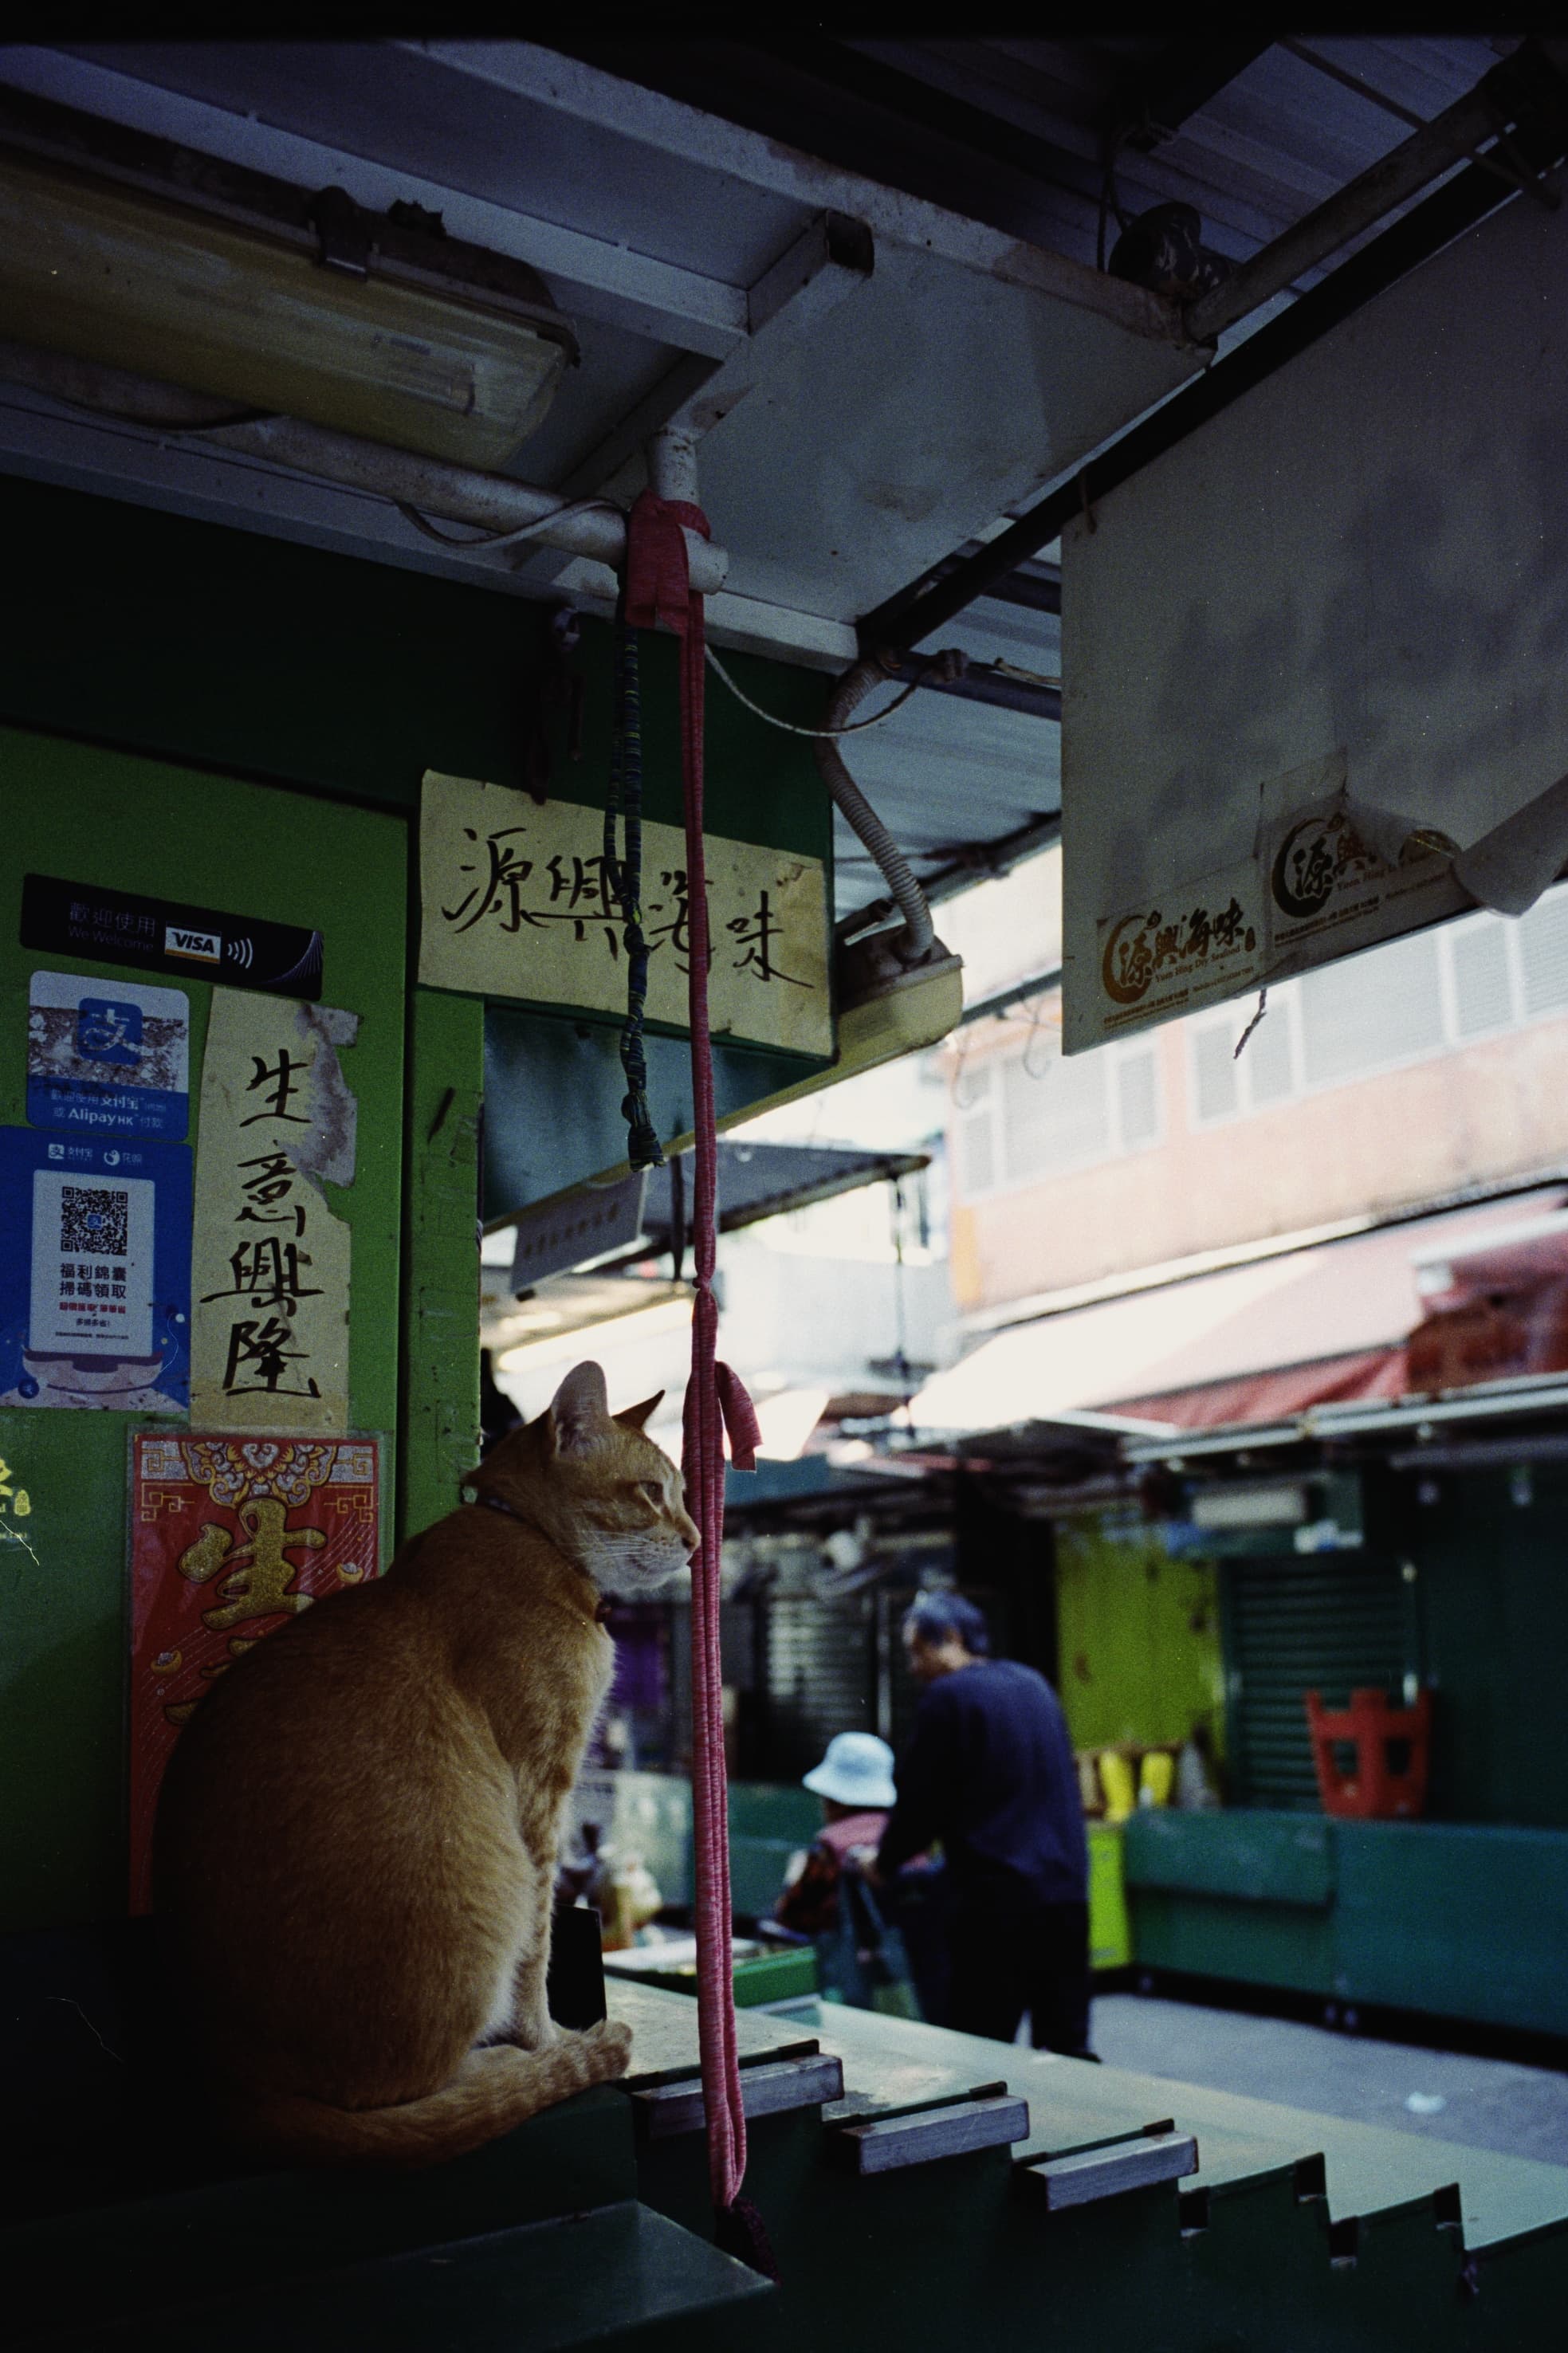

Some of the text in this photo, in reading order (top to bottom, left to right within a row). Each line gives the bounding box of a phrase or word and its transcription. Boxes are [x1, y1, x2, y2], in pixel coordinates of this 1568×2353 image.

[69, 902, 156, 938] 歡迎使用
[69, 925, 154, 953] We Welcome
[172, 931, 215, 954] VISA
[200, 1049, 324, 1399] 生意興隆
[60, 1263, 127, 1283] 福利錦囊
[59, 1281, 127, 1299] 掃碼領取
